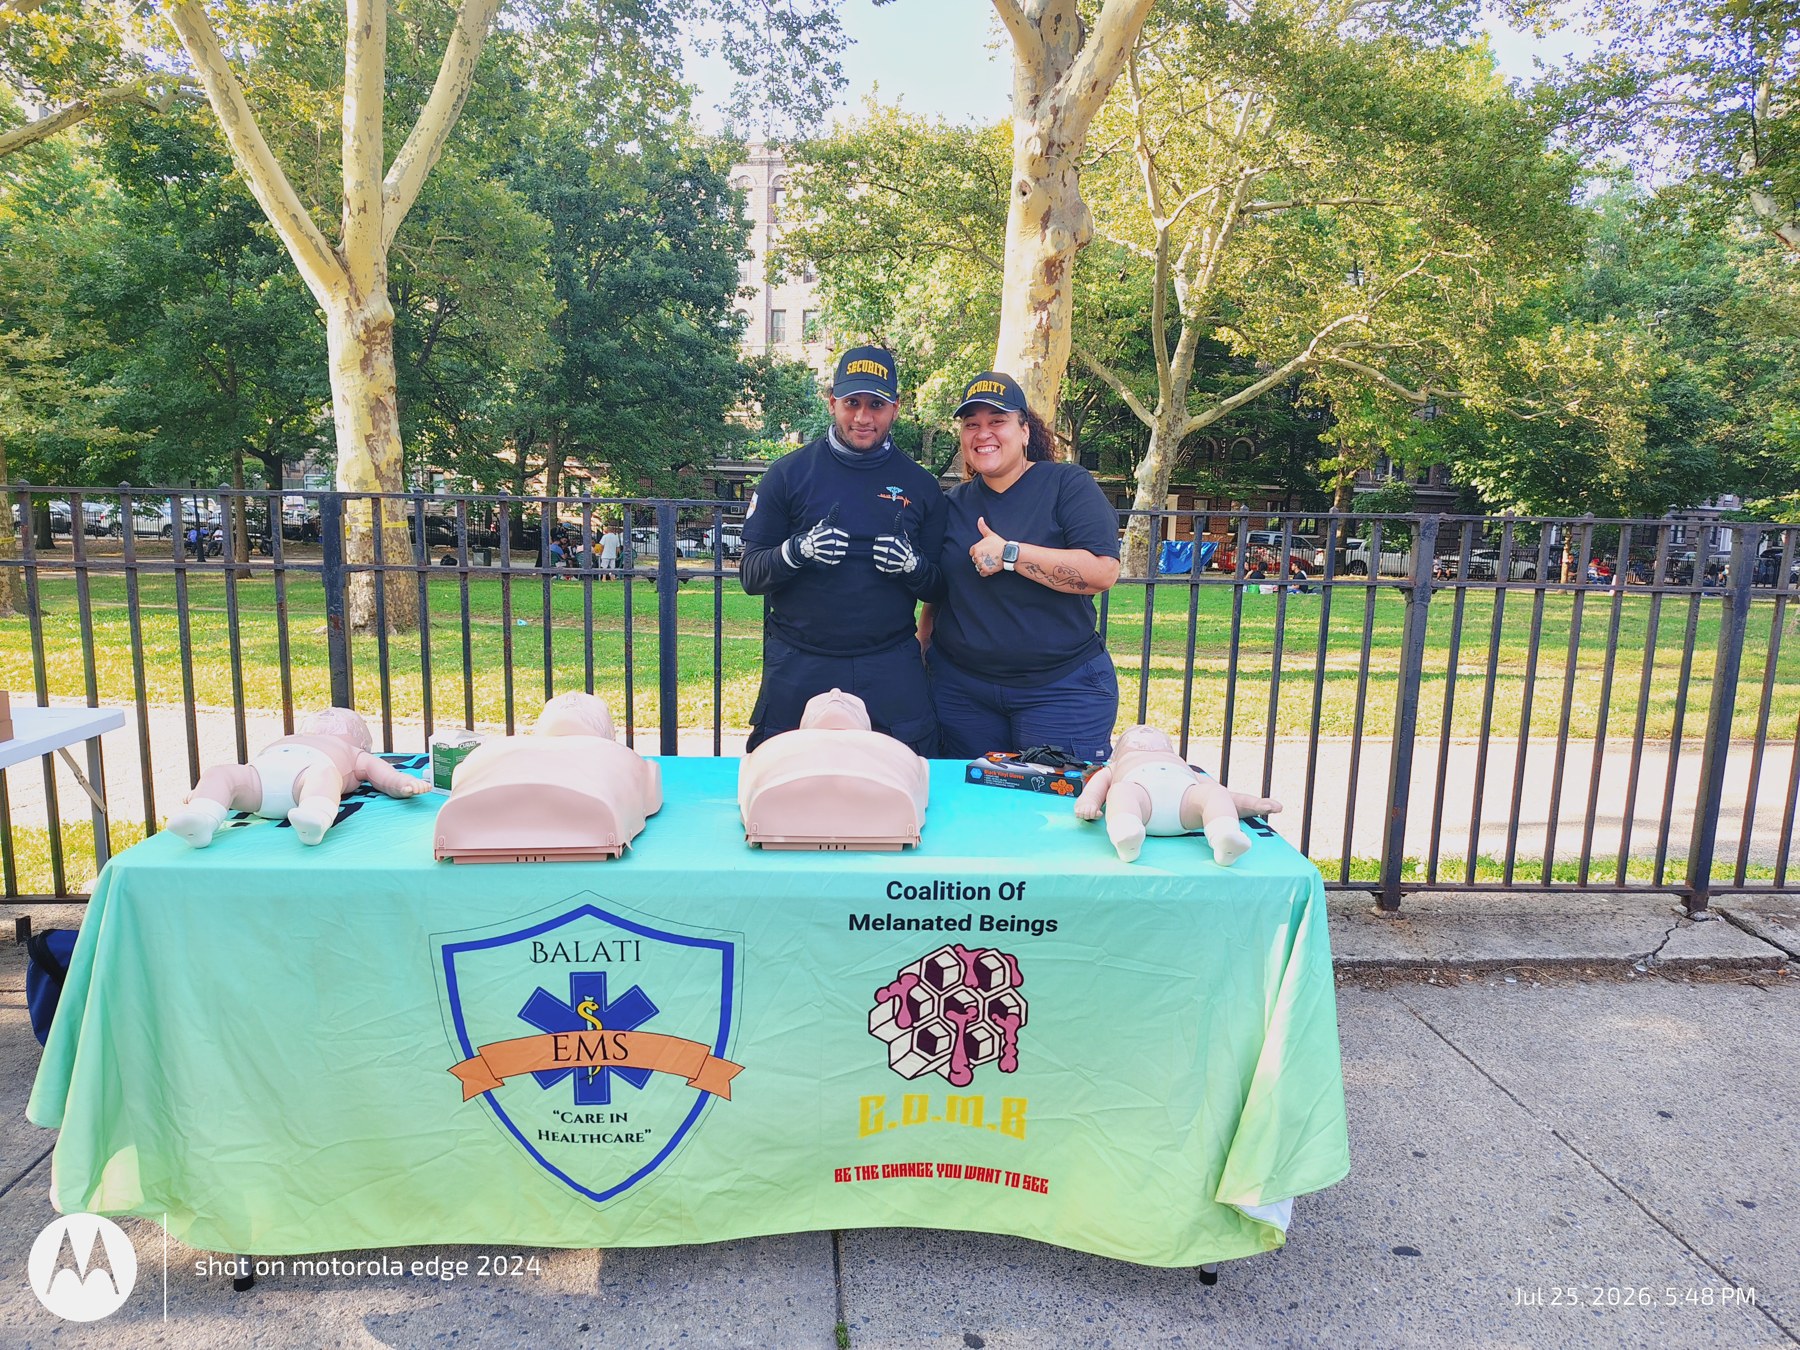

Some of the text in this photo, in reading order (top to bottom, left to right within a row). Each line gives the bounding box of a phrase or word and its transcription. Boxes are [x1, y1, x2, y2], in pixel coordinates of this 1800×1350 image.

[846, 359, 888, 380] SECURITY
[966, 380, 1006, 400] SECURITY
[886, 880, 1027, 901] Coalition Of
[849, 914, 1059, 936] Melanated Beings
[529, 940, 642, 964] BALATI
[551, 1033, 630, 1062] EMS
[834, 1163, 1049, 1194] BE THE CHANGE YOU WANT TO SEE
